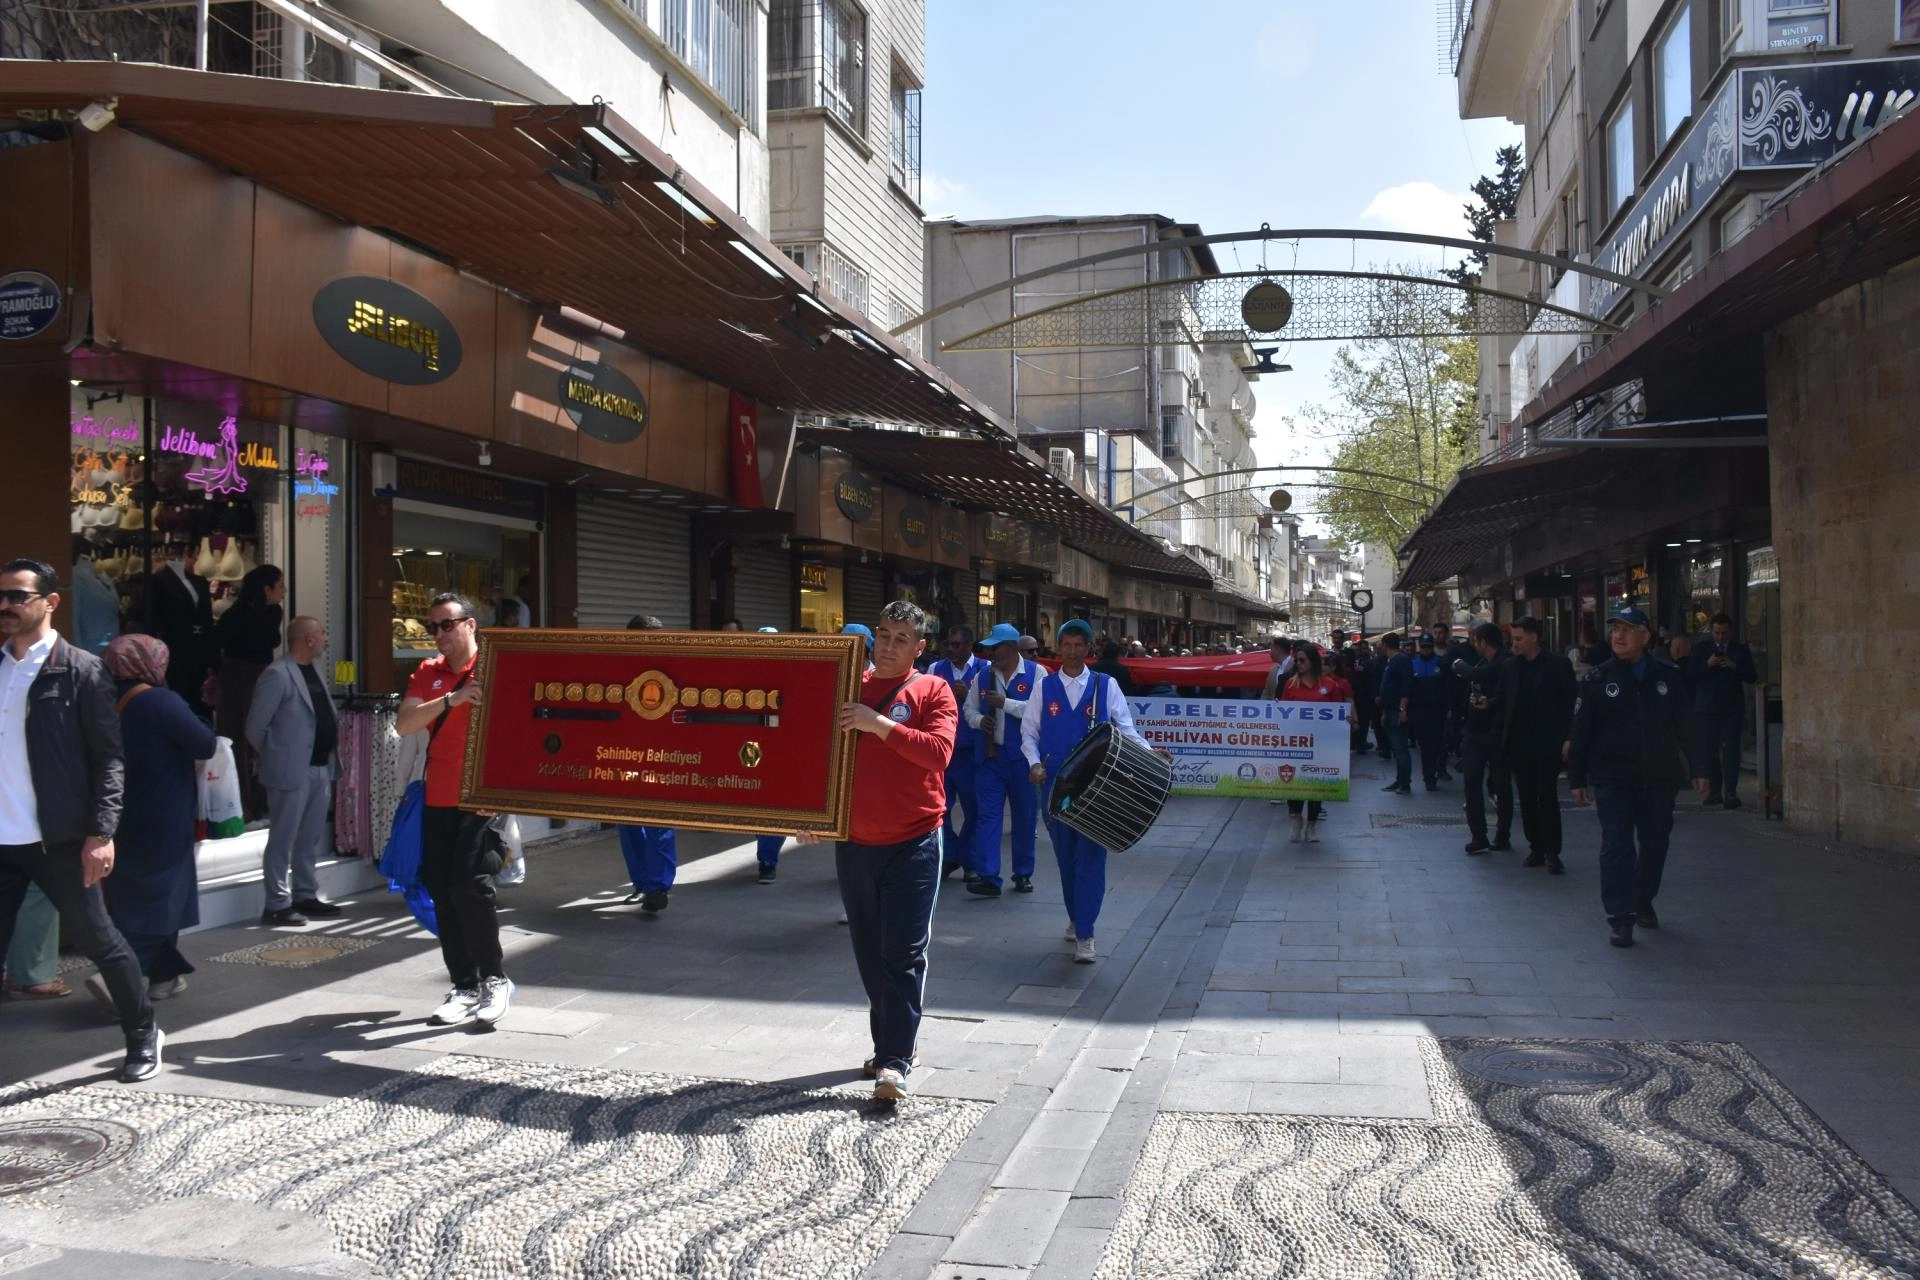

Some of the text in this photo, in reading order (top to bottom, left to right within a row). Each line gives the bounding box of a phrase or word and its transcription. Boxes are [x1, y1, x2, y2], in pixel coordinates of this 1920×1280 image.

[1649, 161, 1689, 249] MODA
[568, 379, 602, 408] MAYDA
[1165, 702, 1346, 721] BELEDİYESİ
[1144, 729, 1314, 748] PEHLİVAN GÜREŞLERİ
[596, 745, 702, 765] Şahinbey Belediyesi
[594, 767, 639, 782] Pehlivan
[641, 769, 689, 787] Güreşleri
